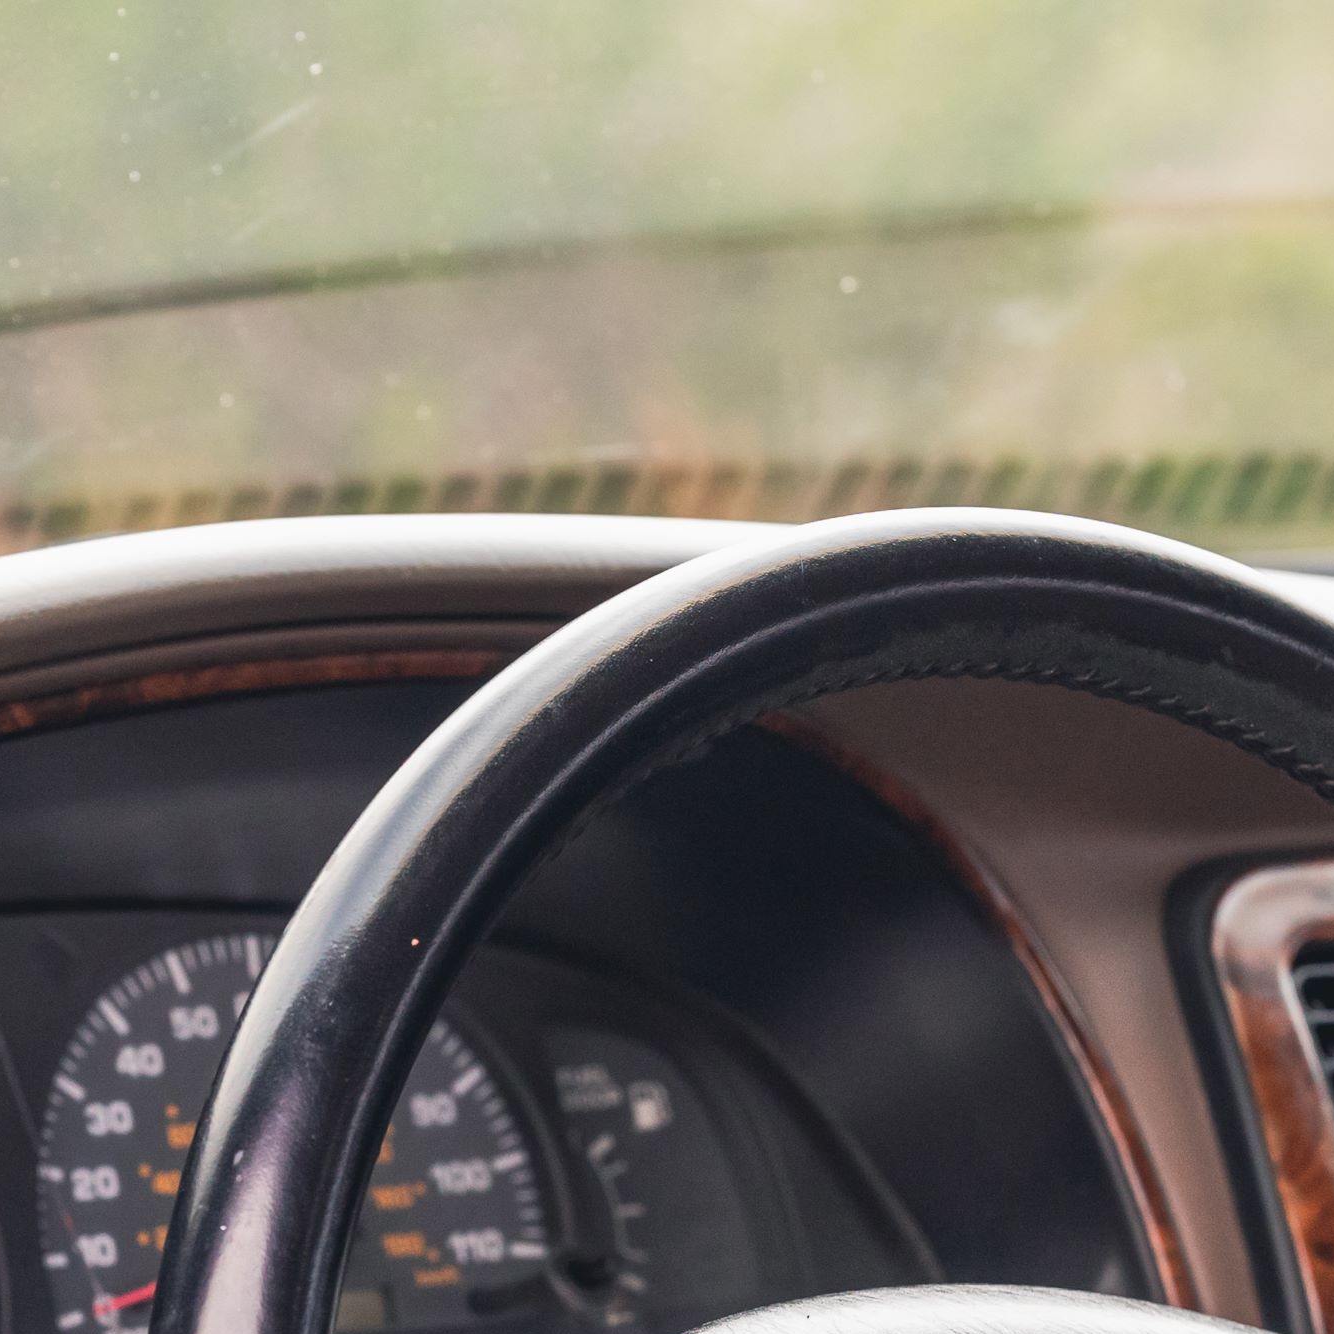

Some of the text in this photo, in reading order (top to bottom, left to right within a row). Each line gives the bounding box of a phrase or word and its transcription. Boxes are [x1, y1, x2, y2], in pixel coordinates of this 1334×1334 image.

[84, 1100, 134, 1137] 30
[70, 1164, 121, 1201] 20
[76, 1231, 119, 1269] 10
